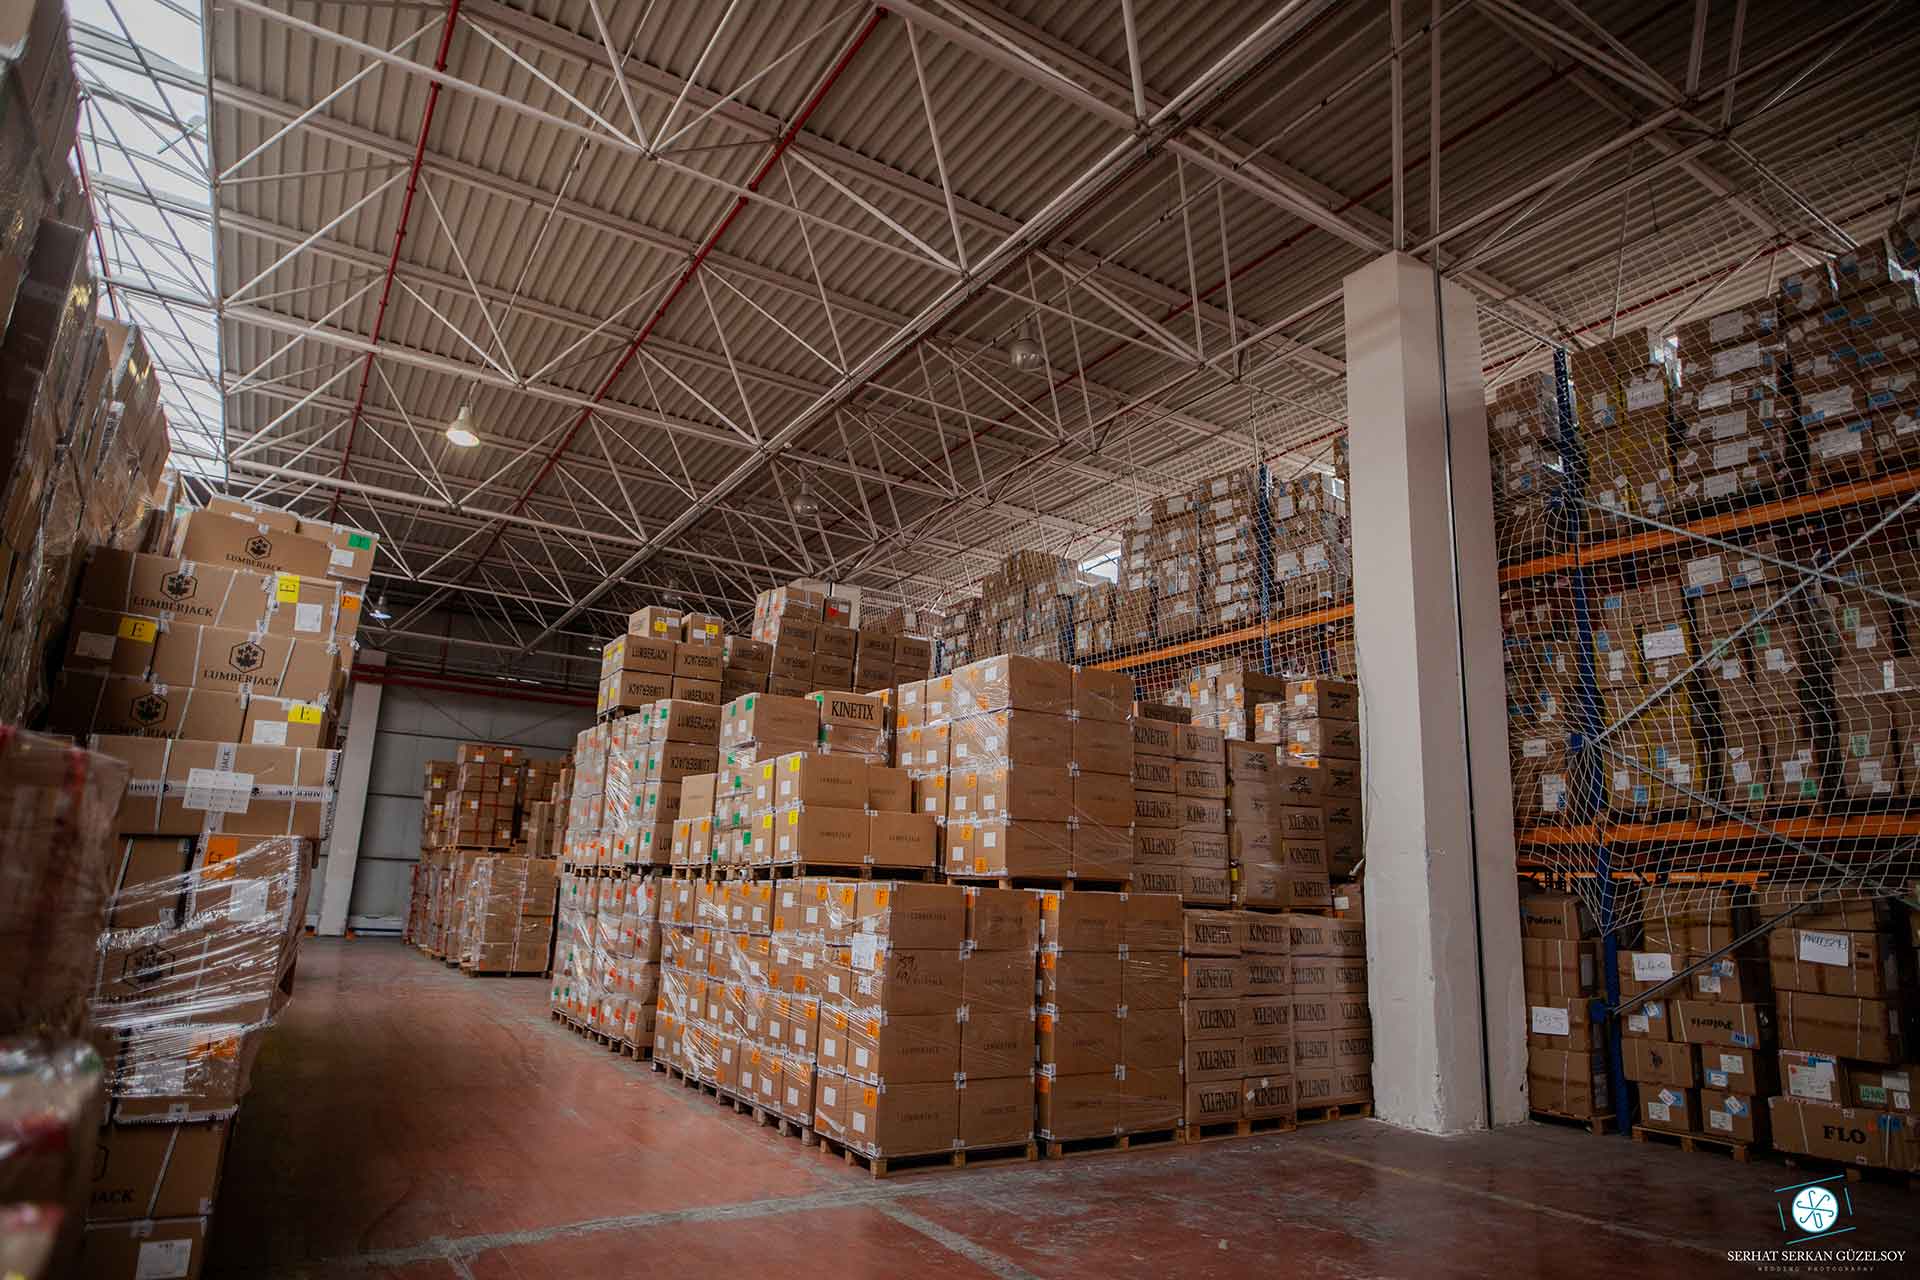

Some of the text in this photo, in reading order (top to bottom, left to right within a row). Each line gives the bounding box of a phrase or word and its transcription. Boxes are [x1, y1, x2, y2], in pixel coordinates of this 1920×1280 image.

[133, 595, 214, 618] LUMBERJACK
[204, 669, 280, 687] LUMBERJACK
[831, 700, 875, 721] KINETIX
[1134, 726, 1169, 747] KINETIX
[1140, 837, 1177, 856] KINETIX
[1195, 923, 1233, 944] KINETIX
[1196, 968, 1233, 989] KINETIX
[1198, 1008, 1237, 1029] KINETIX
[1197, 1049, 1237, 1070] KINETIX
[1823, 1125, 1866, 1144] FLO
